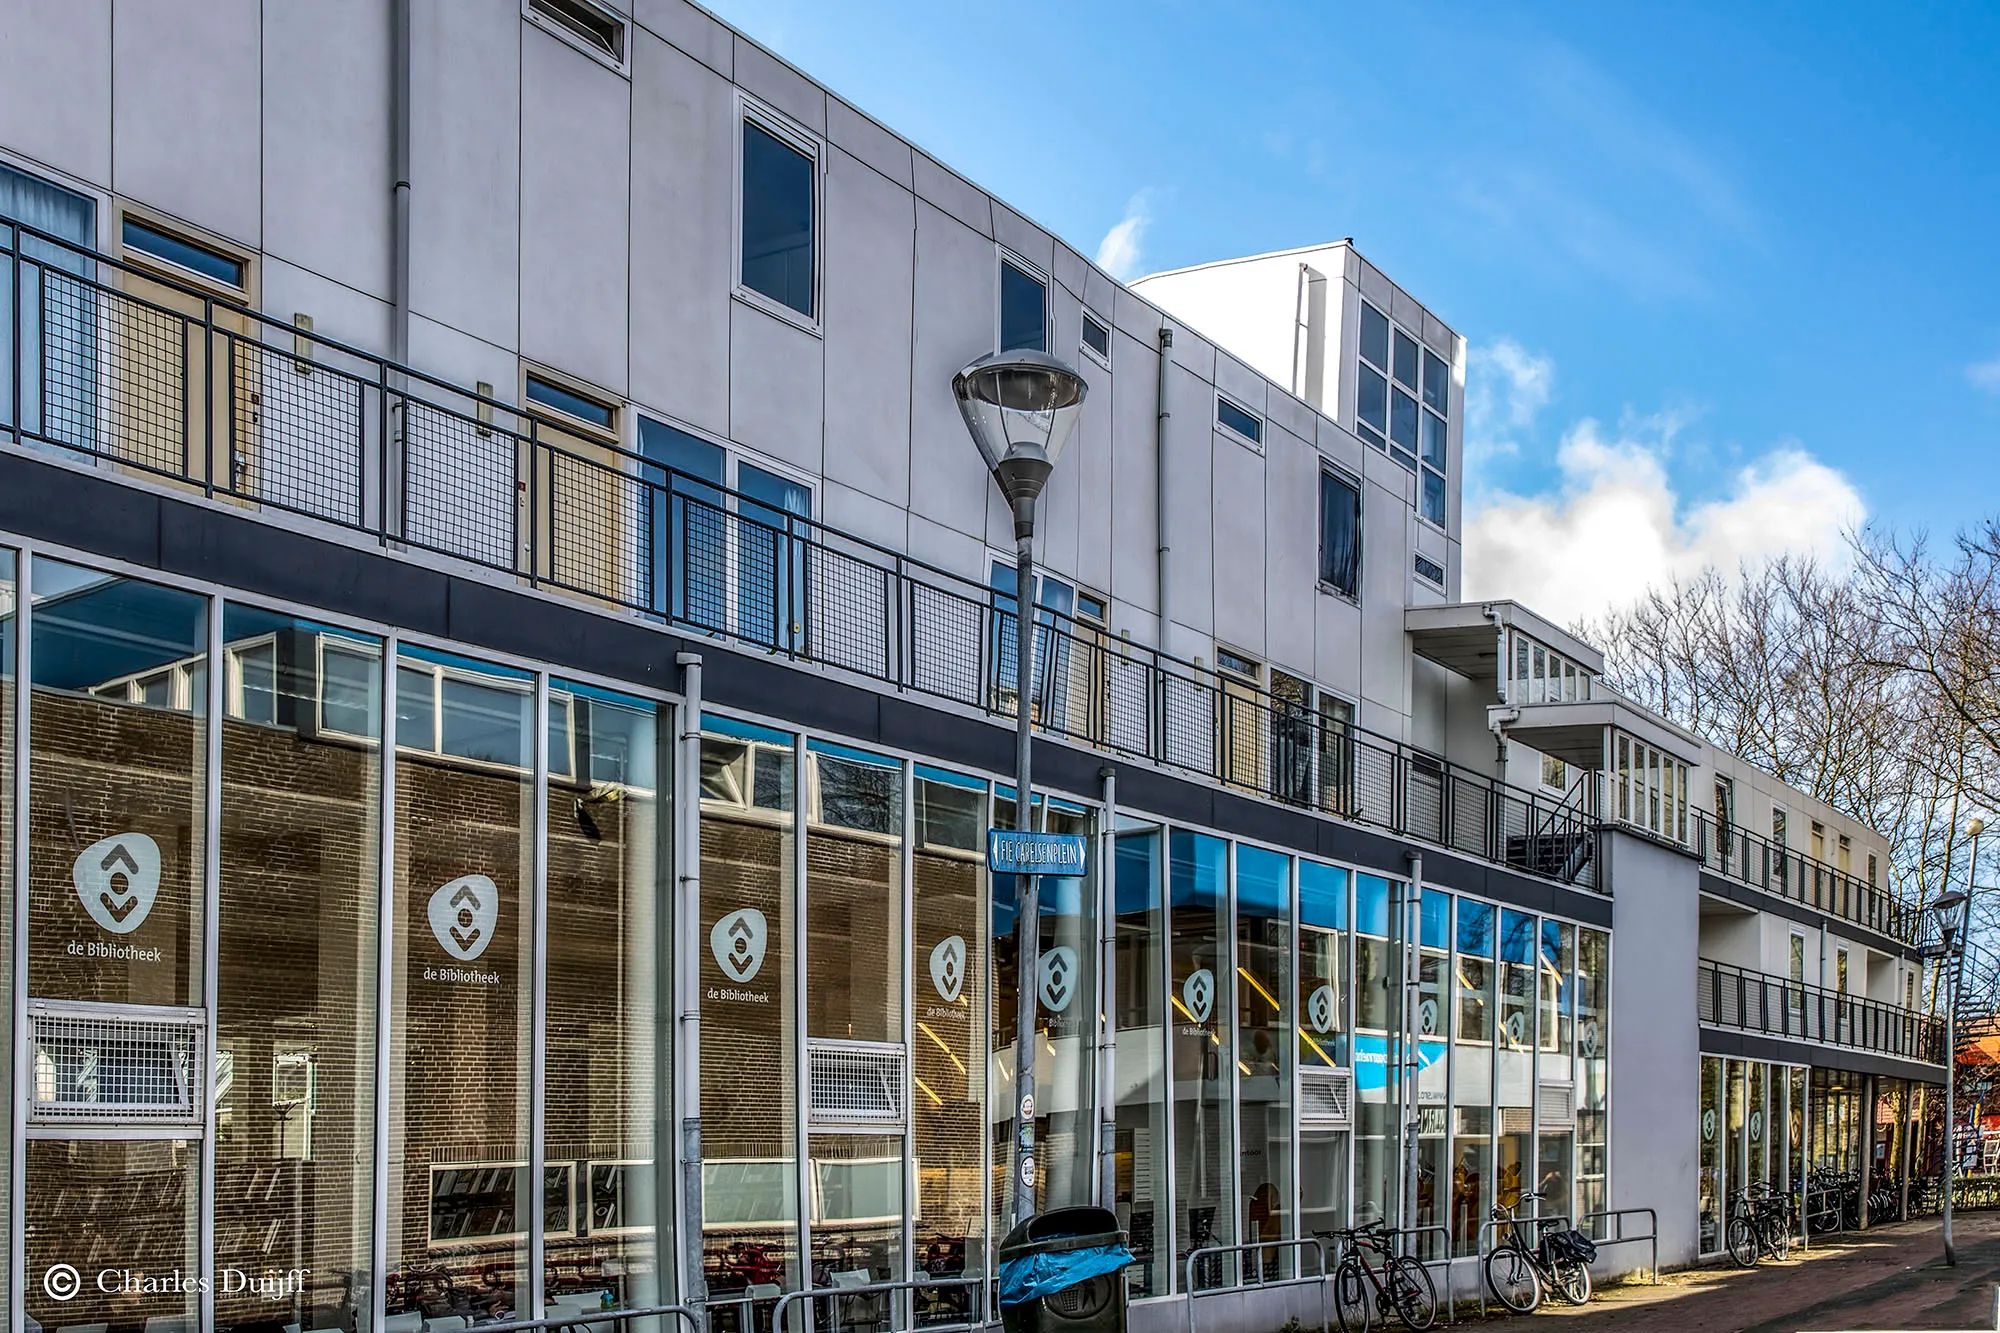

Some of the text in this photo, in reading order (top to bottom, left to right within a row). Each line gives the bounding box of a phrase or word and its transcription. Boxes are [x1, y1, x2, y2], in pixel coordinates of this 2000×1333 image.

[1001, 840, 1077, 864] FIE CARELSENPLEIN
[67, 940, 161, 962] de Bibliotheek
[423, 967, 500, 984] de Bibliotheek
[707, 987, 769, 1003] de Bibliotheek
[926, 1006, 936, 1017] de
[1182, 1027, 1190, 1035] de
